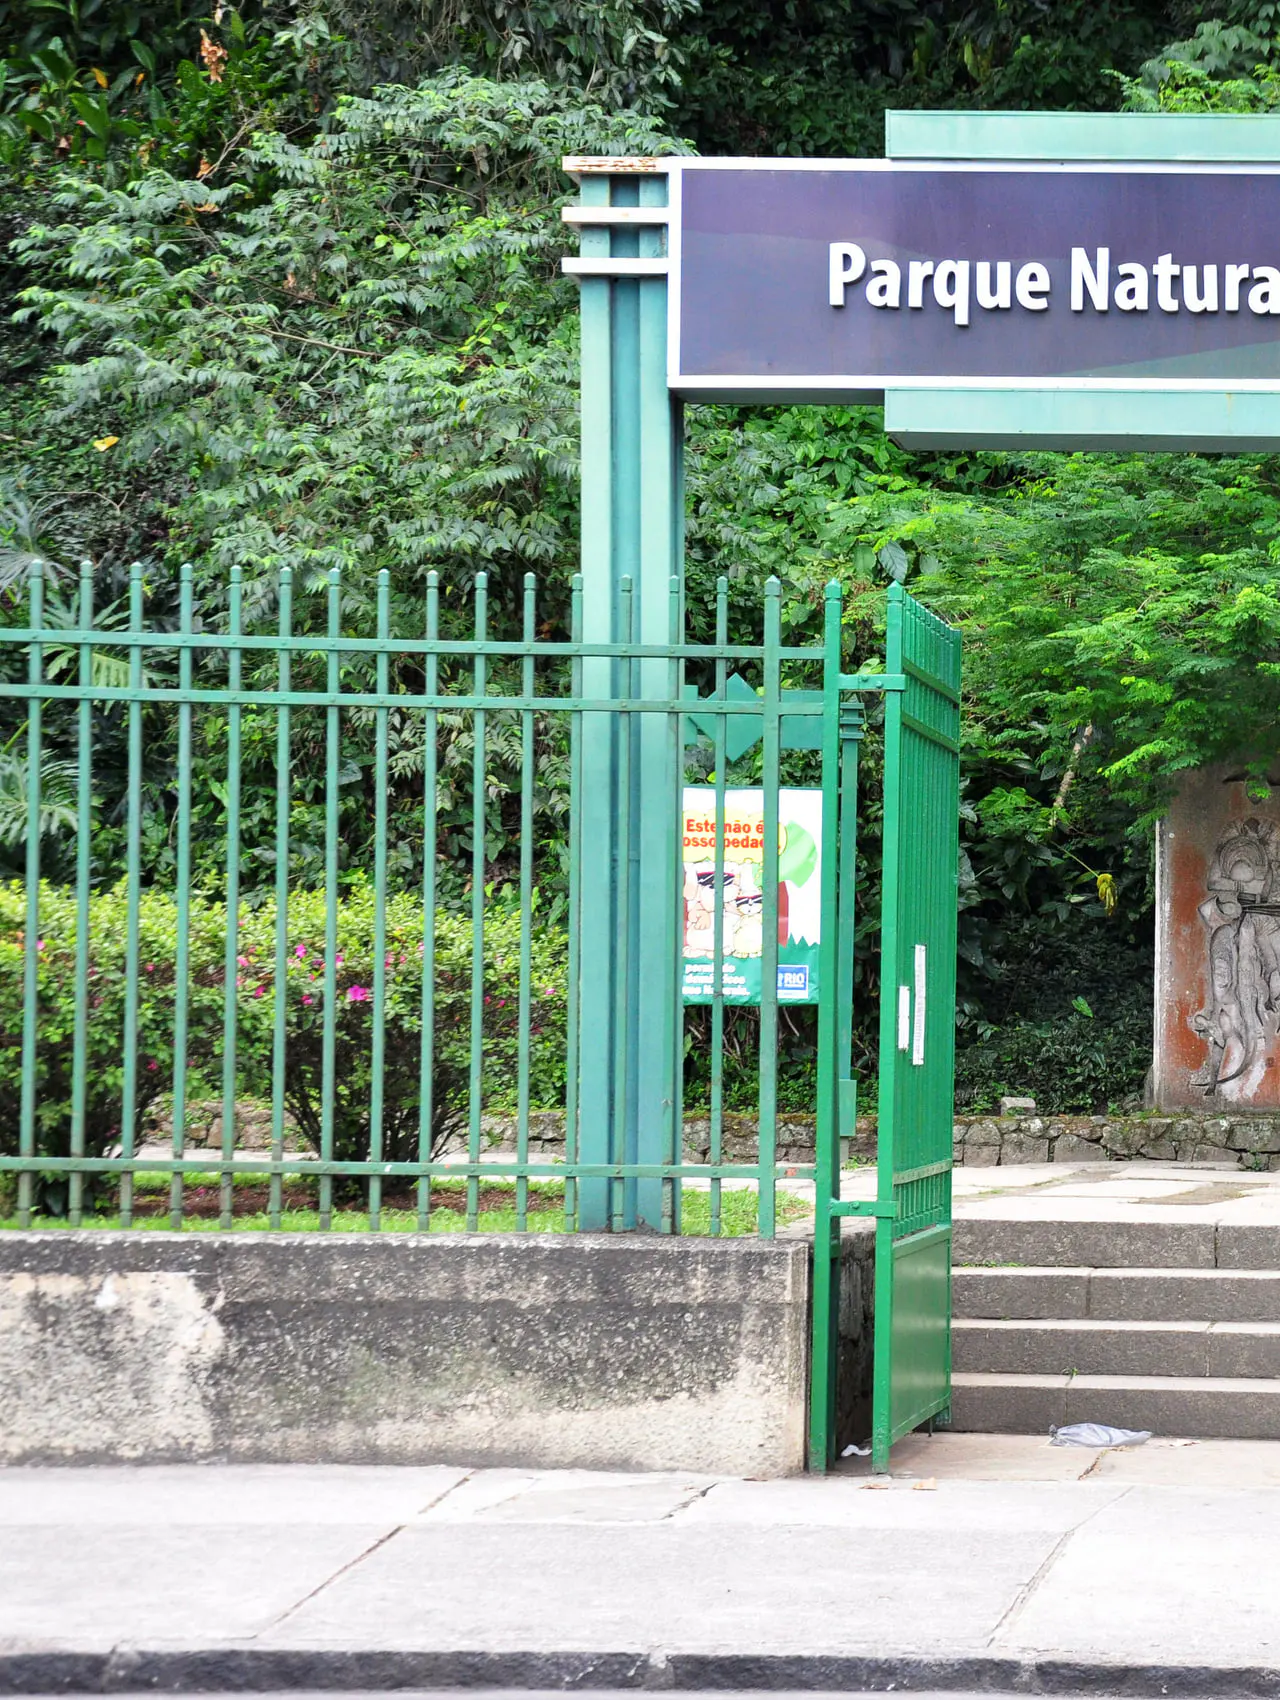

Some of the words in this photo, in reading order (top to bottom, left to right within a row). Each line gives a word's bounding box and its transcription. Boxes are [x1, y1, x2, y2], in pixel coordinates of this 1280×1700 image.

[828, 238, 1050, 326] Parque
[686, 819, 716, 832] Este
[723, 819, 751, 833] não
[683, 836, 716, 848] osso
[784, 973, 804, 984] RIO
